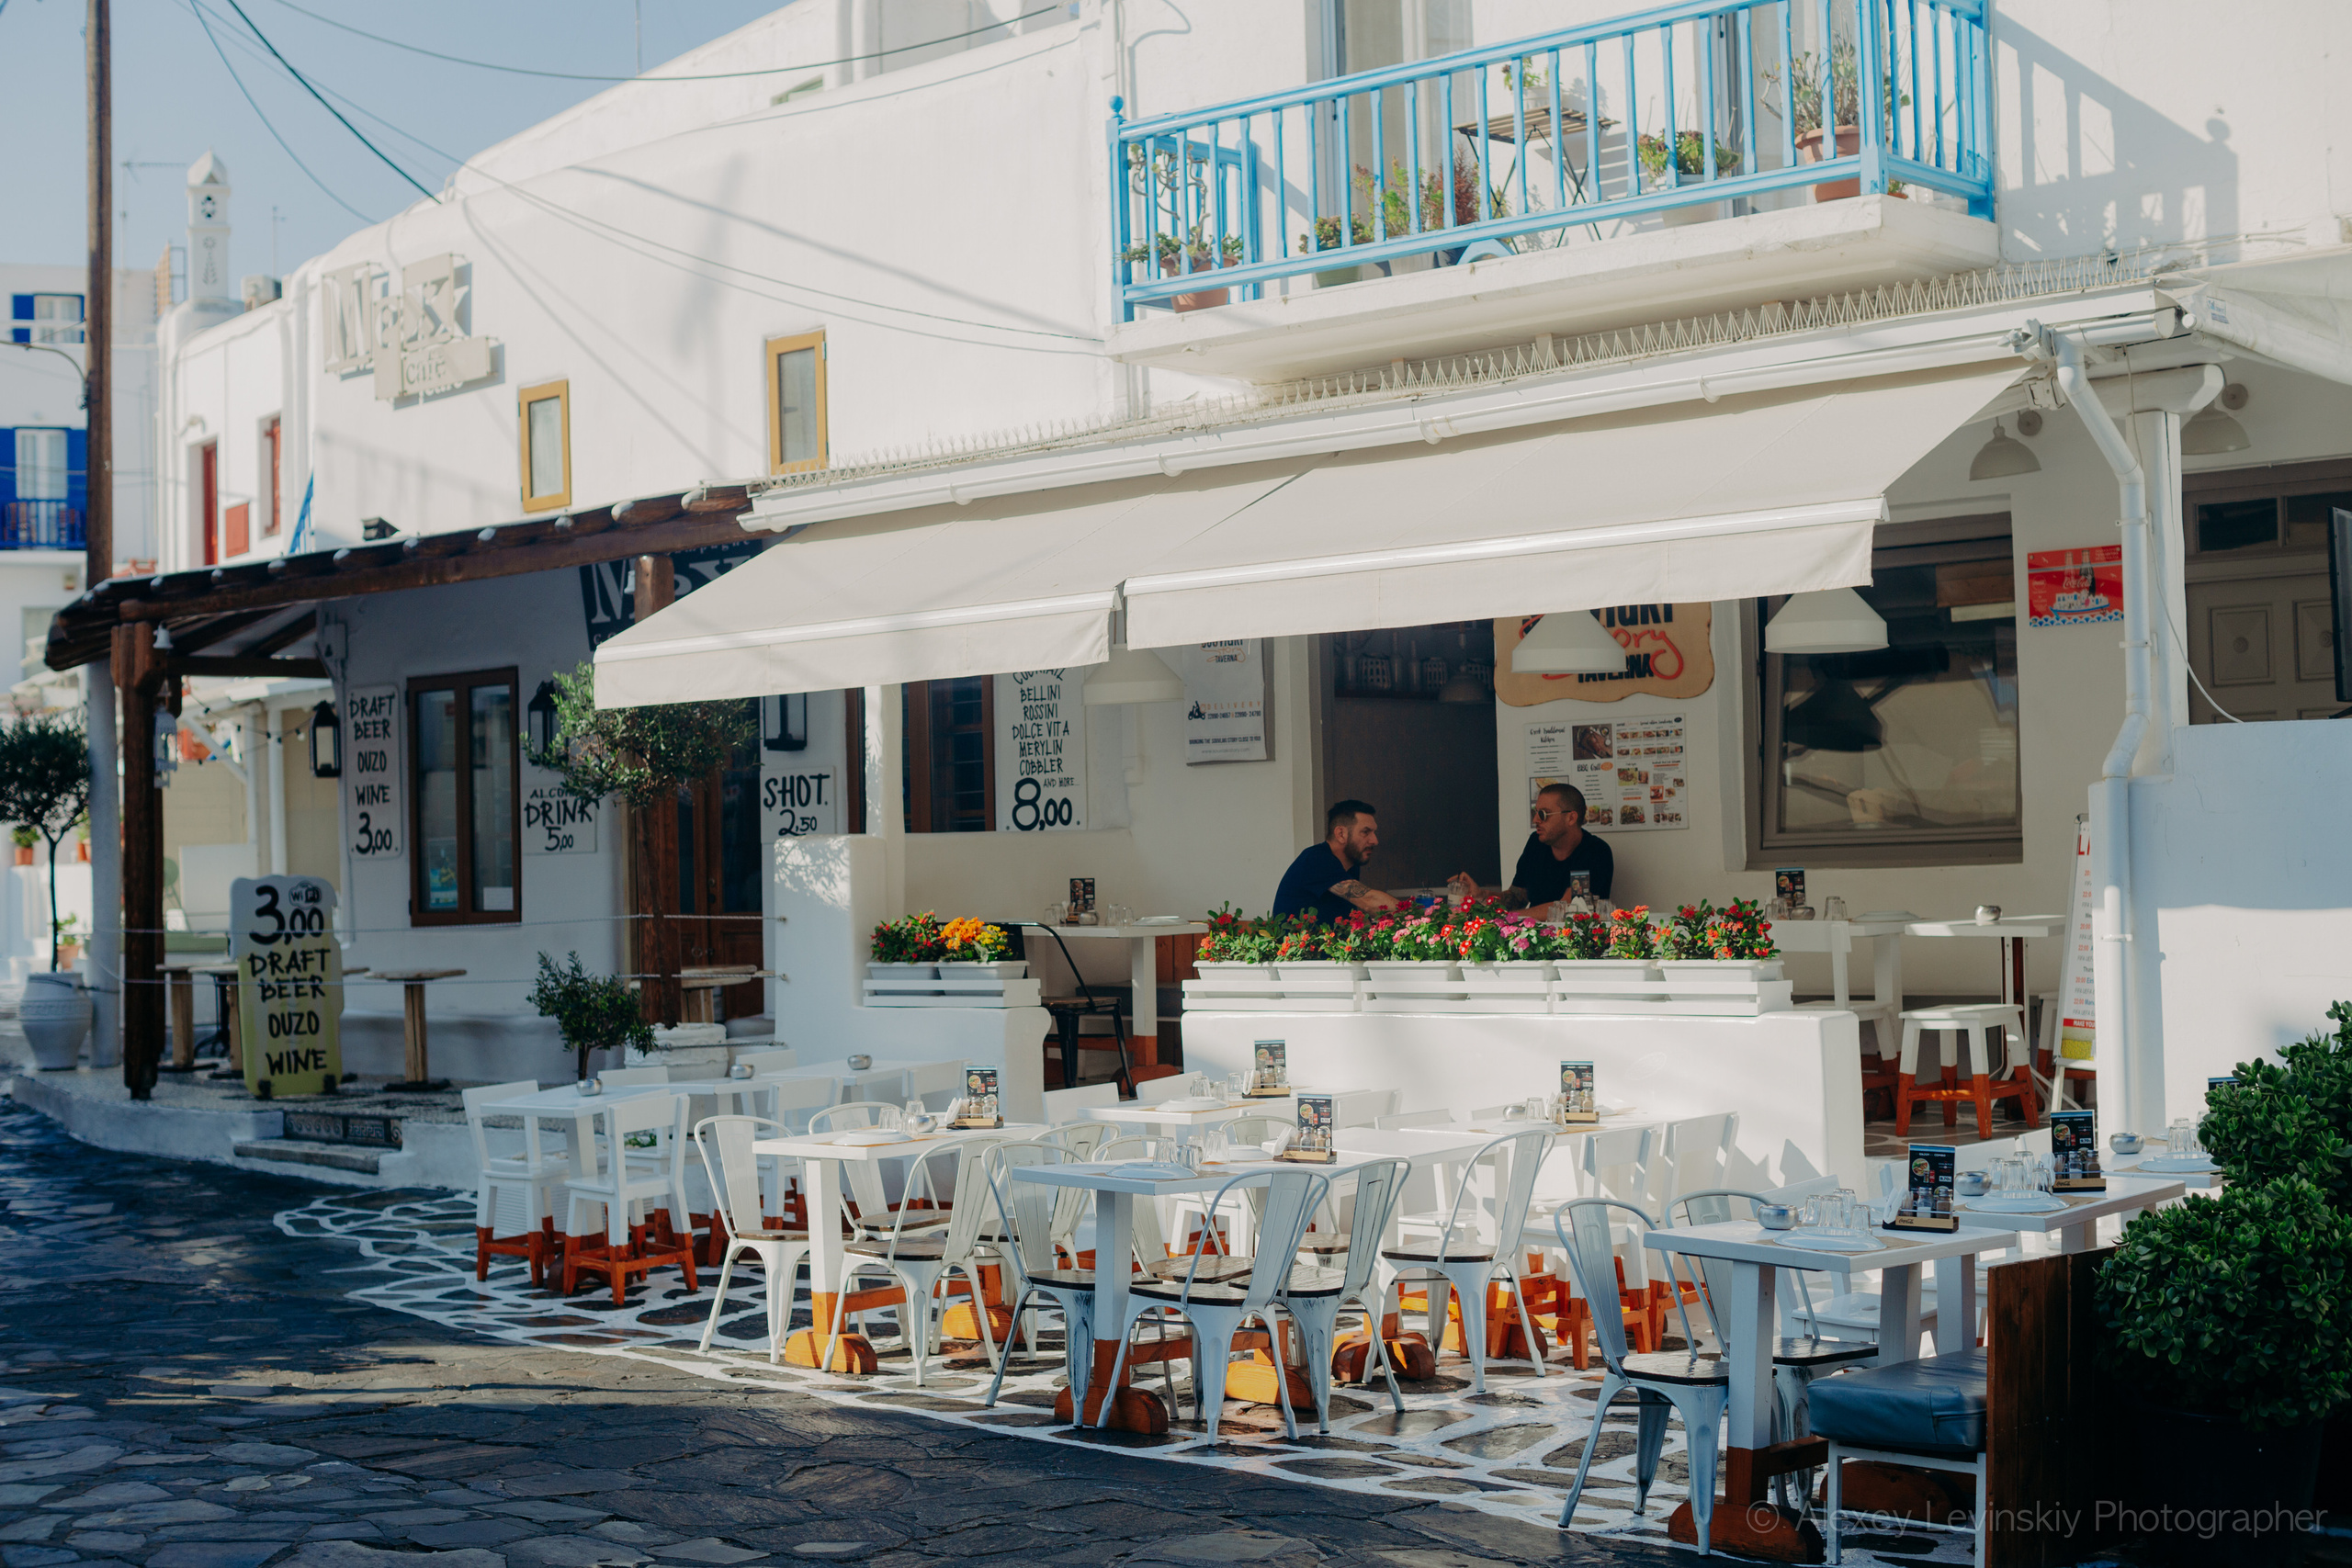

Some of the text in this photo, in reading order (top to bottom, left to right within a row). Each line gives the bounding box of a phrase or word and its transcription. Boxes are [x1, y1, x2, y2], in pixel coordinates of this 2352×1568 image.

[1020, 684, 1061, 703] BELLINI
[349, 693, 395, 718] DRAFT
[1023, 703, 1058, 721] ROSSINI
[1206, 700, 1261, 711] DELIVERY
[354, 718, 391, 741] BEER
[1012, 722, 1044, 740] DOLCE
[1019, 739, 1063, 758] MERYLIN
[357, 750, 387, 773] OUZO
[1020, 757, 1064, 776] COBBLER
[1043, 778, 1057, 788] AND
[356, 784, 390, 807] WINE
[1012, 777, 1073, 831] 8,00
[524, 798, 594, 829] DRINK
[356, 812, 393, 855] 3,00
[545, 827, 574, 852] 5,00
[249, 885, 324, 945] 3,00
[248, 949, 331, 977] DRAFT
[257, 975, 326, 1002] BEER
[268, 1010, 320, 1038] OUZO
[2073, 1019, 2085, 1027] MAKE
[266, 1049, 328, 1077] WINE
